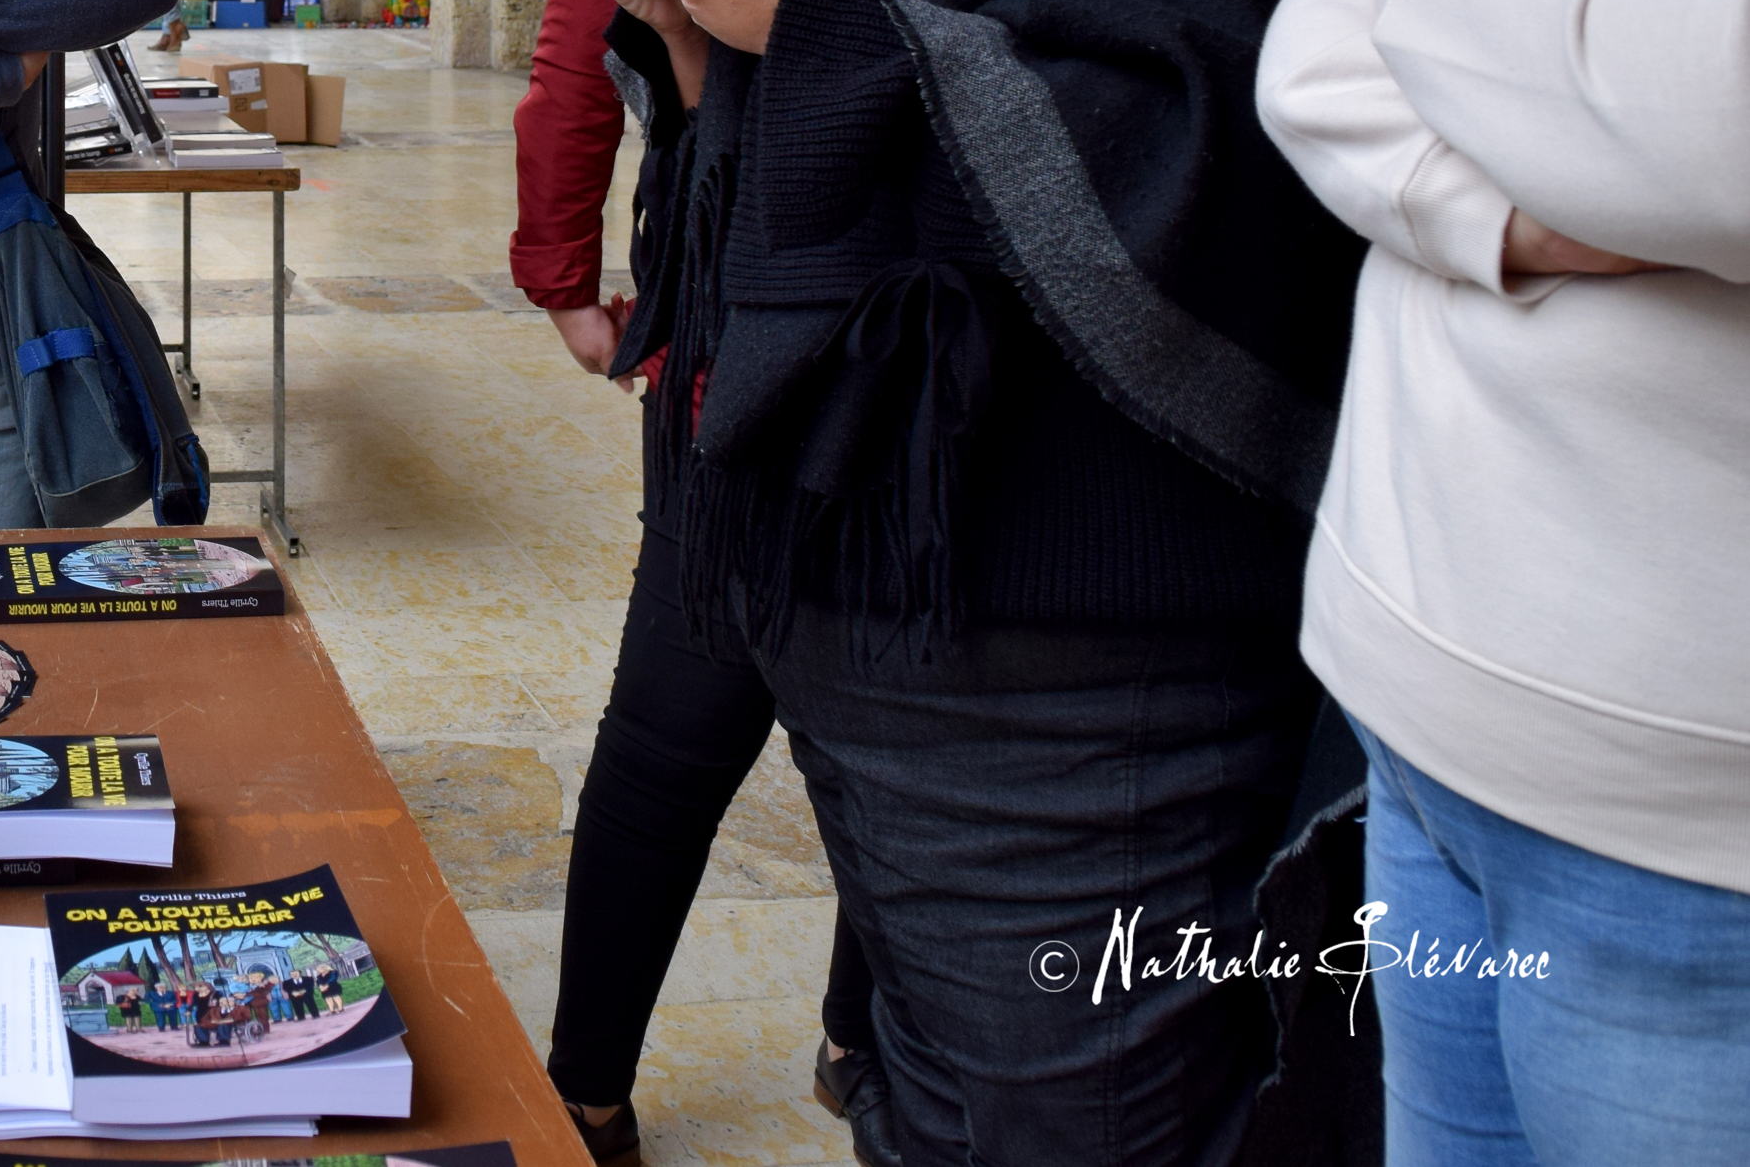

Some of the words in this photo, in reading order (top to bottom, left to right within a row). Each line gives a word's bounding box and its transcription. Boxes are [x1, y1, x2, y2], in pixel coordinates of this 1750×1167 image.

[8, 546, 25, 556] VIE
[10, 556, 27, 564] LA
[12, 564, 31, 579] TOUTE
[36, 572, 56, 586] POUR
[16, 584, 34, 594] ON
[9, 603, 48, 615] MOURIR
[51, 603, 78, 614] POUR
[80, 602, 96, 614] VIE
[100, 601, 113, 613] LA
[115, 601, 147, 612] TOUTE
[150, 600, 158, 611] A
[161, 599, 177, 610] ON
[202, 599, 229, 607] Thiers
[230, 598, 259, 608] Cyrille
[94, 736, 117, 747] ON
[66, 745, 89, 766] POUR
[97, 754, 122, 781] TOUTE
[69, 766, 94, 798] MOURIR
[100, 781, 125, 793] LA
[103, 794, 127, 806] VIE
[3, 861, 41, 874] Cyrille
[139, 894, 192, 903] Cyrille
[194, 890, 247, 900] Thiers
[66, 909, 107, 922] ON
[117, 907, 138, 920] A
[146, 904, 232, 919] TOUTE
[239, 899, 275, 915] LA
[282, 887, 325, 906] VIE
[107, 920, 180, 934] POUR
[189, 909, 295, 931] MOURIR
